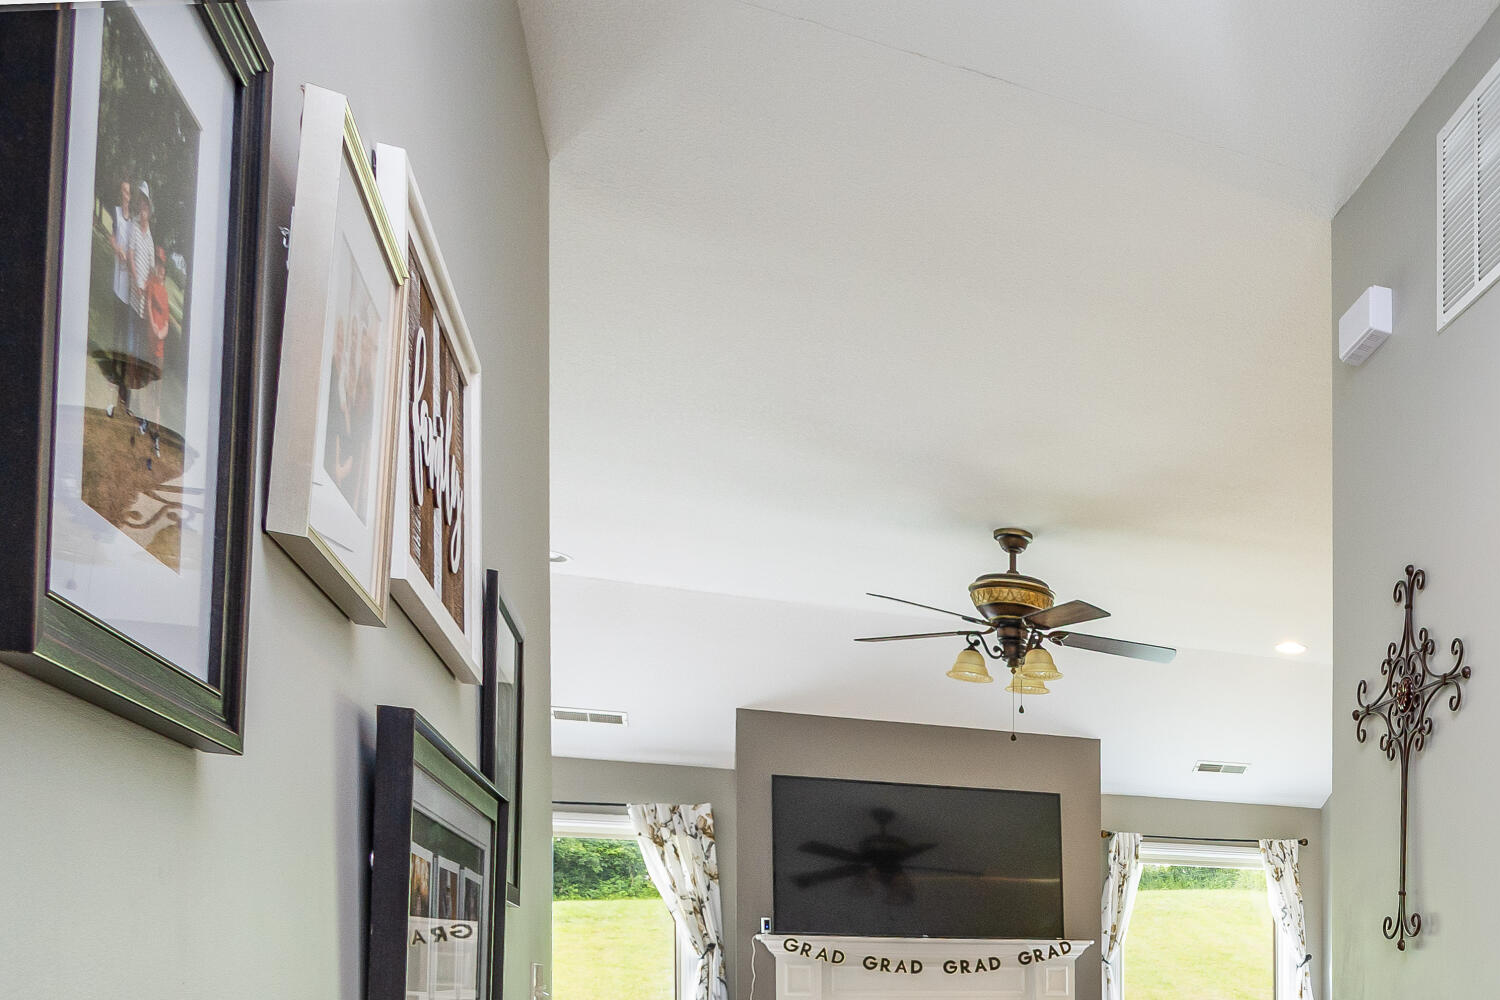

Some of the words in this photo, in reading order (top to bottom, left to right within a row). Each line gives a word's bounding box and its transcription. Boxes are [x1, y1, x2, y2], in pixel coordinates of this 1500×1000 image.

[412, 326, 464, 574] family
[783, 938, 846, 965] GRAD
[862, 955, 924, 975] GRAD
[943, 956, 1001, 974] GRAD
[1018, 940, 1072, 966] GRAD
